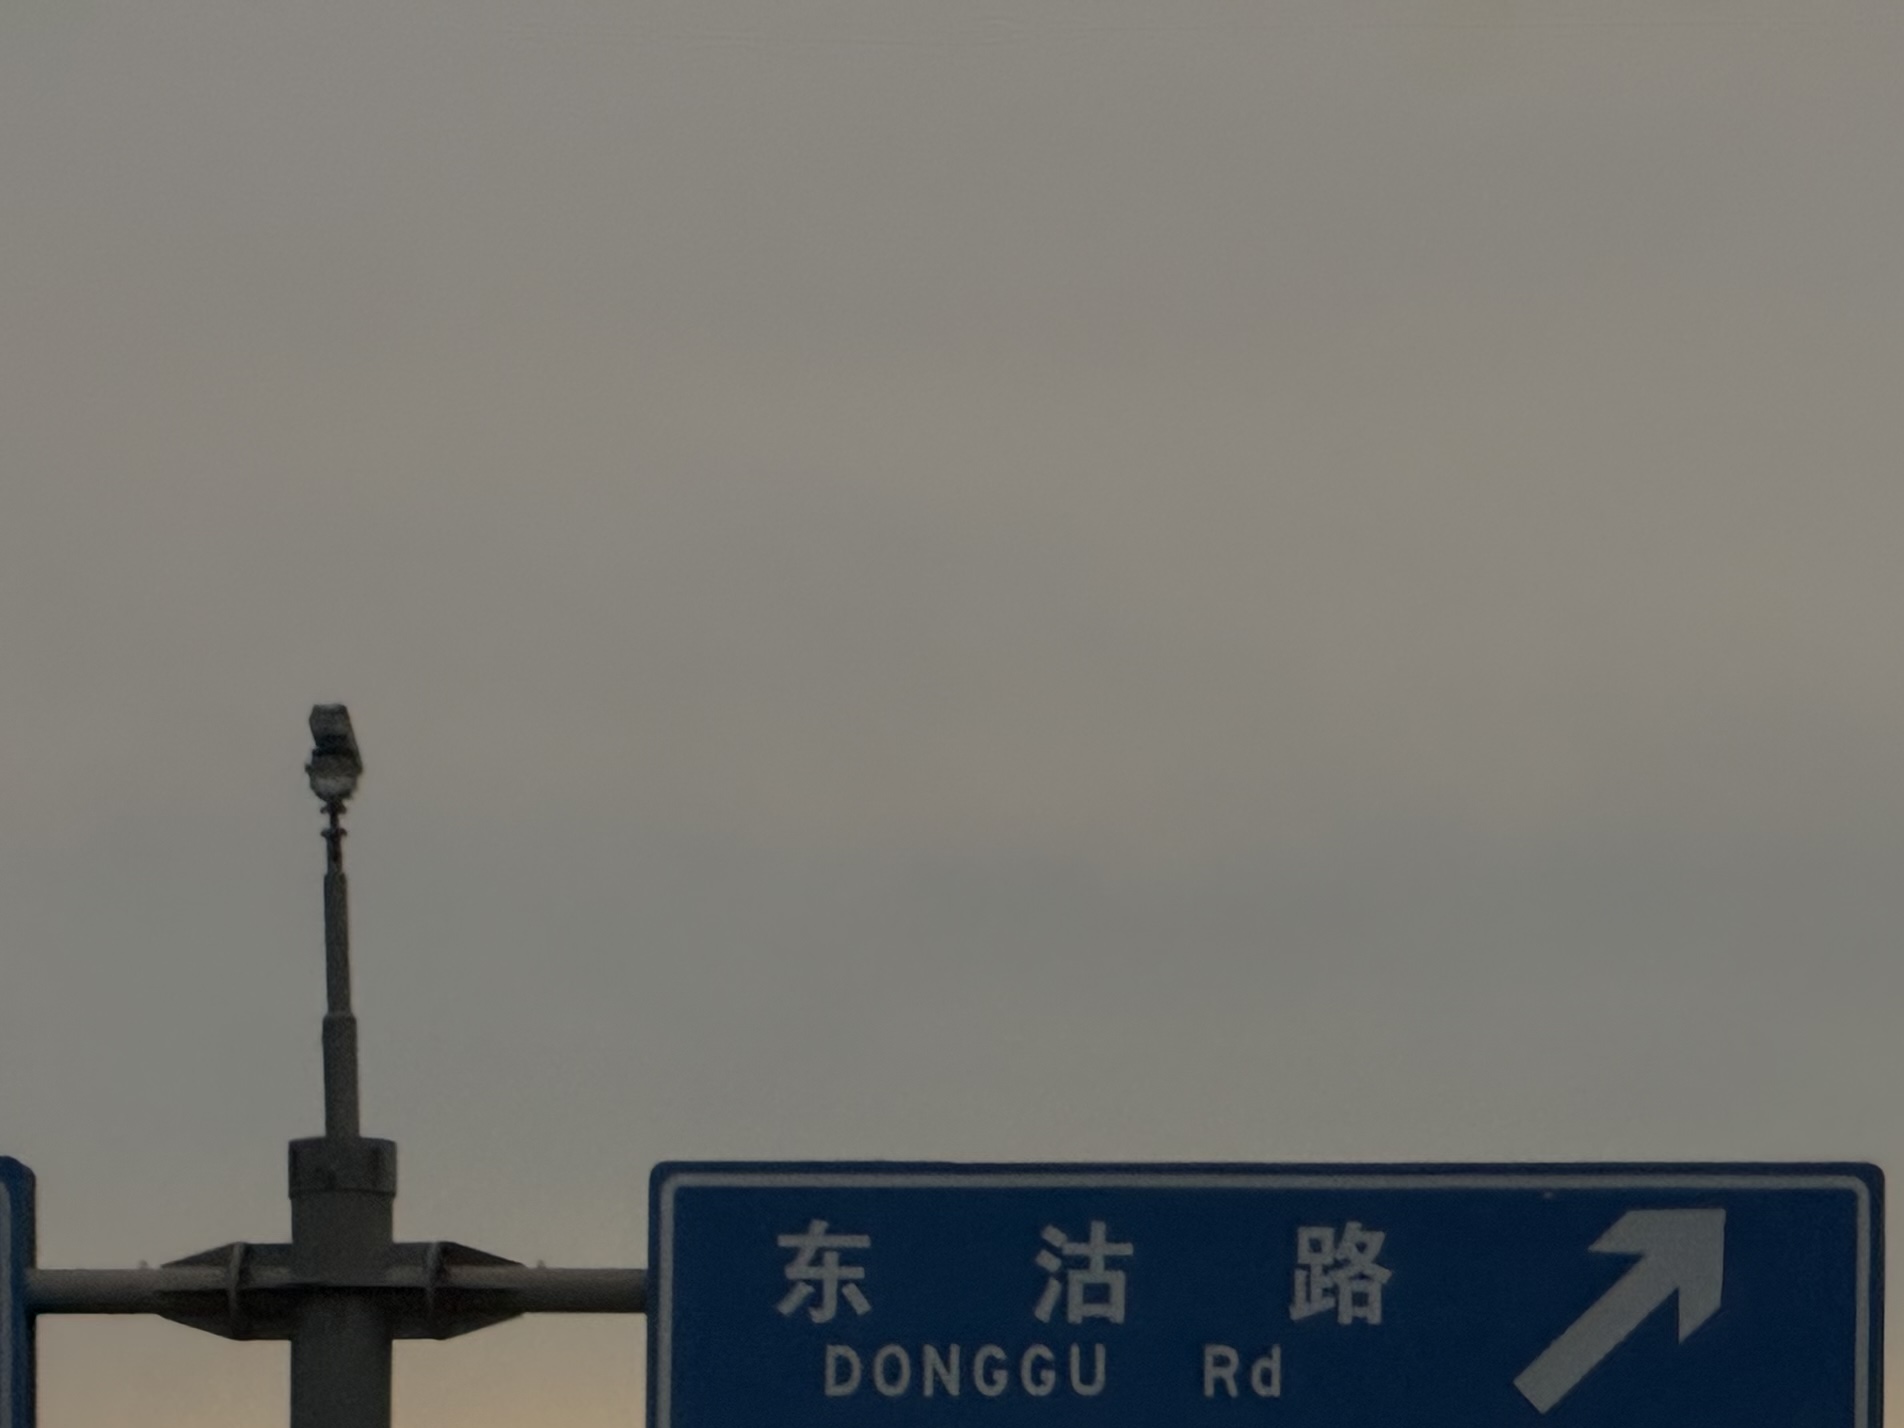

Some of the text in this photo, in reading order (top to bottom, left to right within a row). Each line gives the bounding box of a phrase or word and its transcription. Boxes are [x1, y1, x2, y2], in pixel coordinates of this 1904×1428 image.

[776, 1219, 1393, 1325] 东沽路
[824, 1343, 1282, 1398] DONGGU Rd
